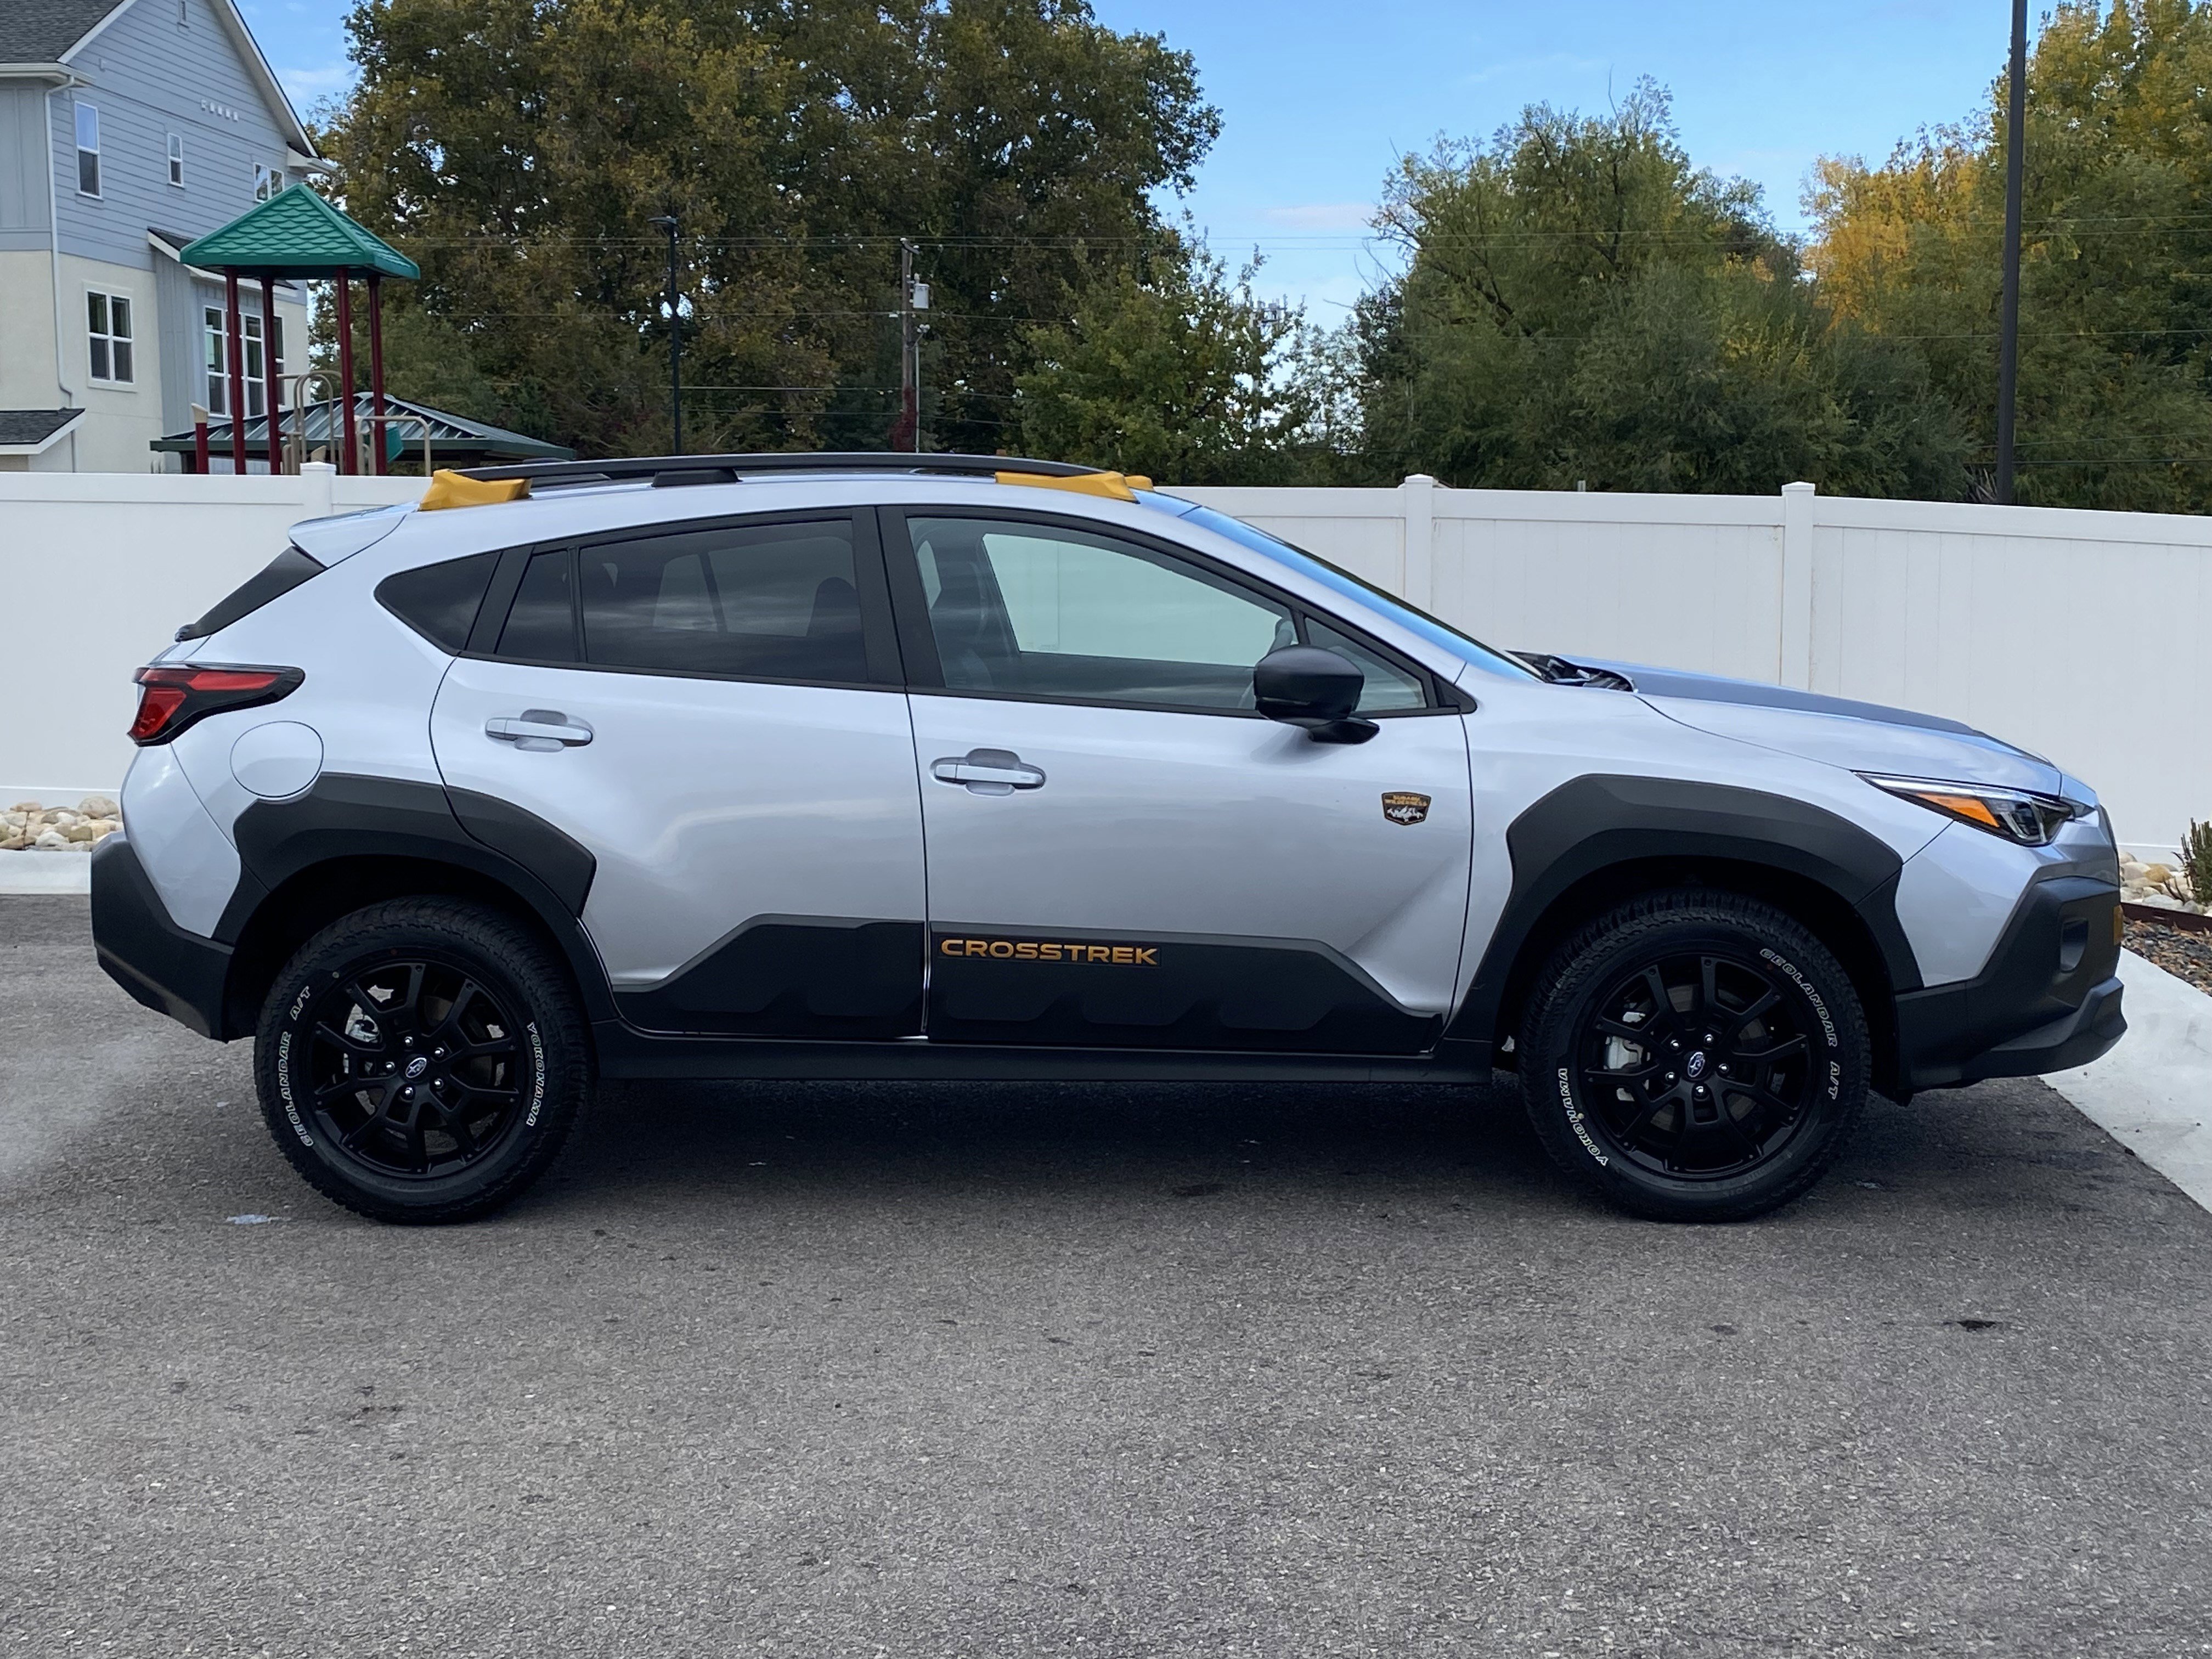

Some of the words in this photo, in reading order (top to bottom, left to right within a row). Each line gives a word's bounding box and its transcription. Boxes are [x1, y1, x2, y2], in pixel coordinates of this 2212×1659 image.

[290, 985, 311, 1021] A/T
[940, 939, 1158, 965] CROSSTREK
[526, 1022, 545, 1127] YOKOHAMA
[1759, 948, 1838, 1047] GEOLANDAR
[1827, 1060, 1840, 1101] A/T
[278, 1031, 314, 1147] GEOLANDAR
[1558, 1068, 1609, 1167] YOKOHAMA
